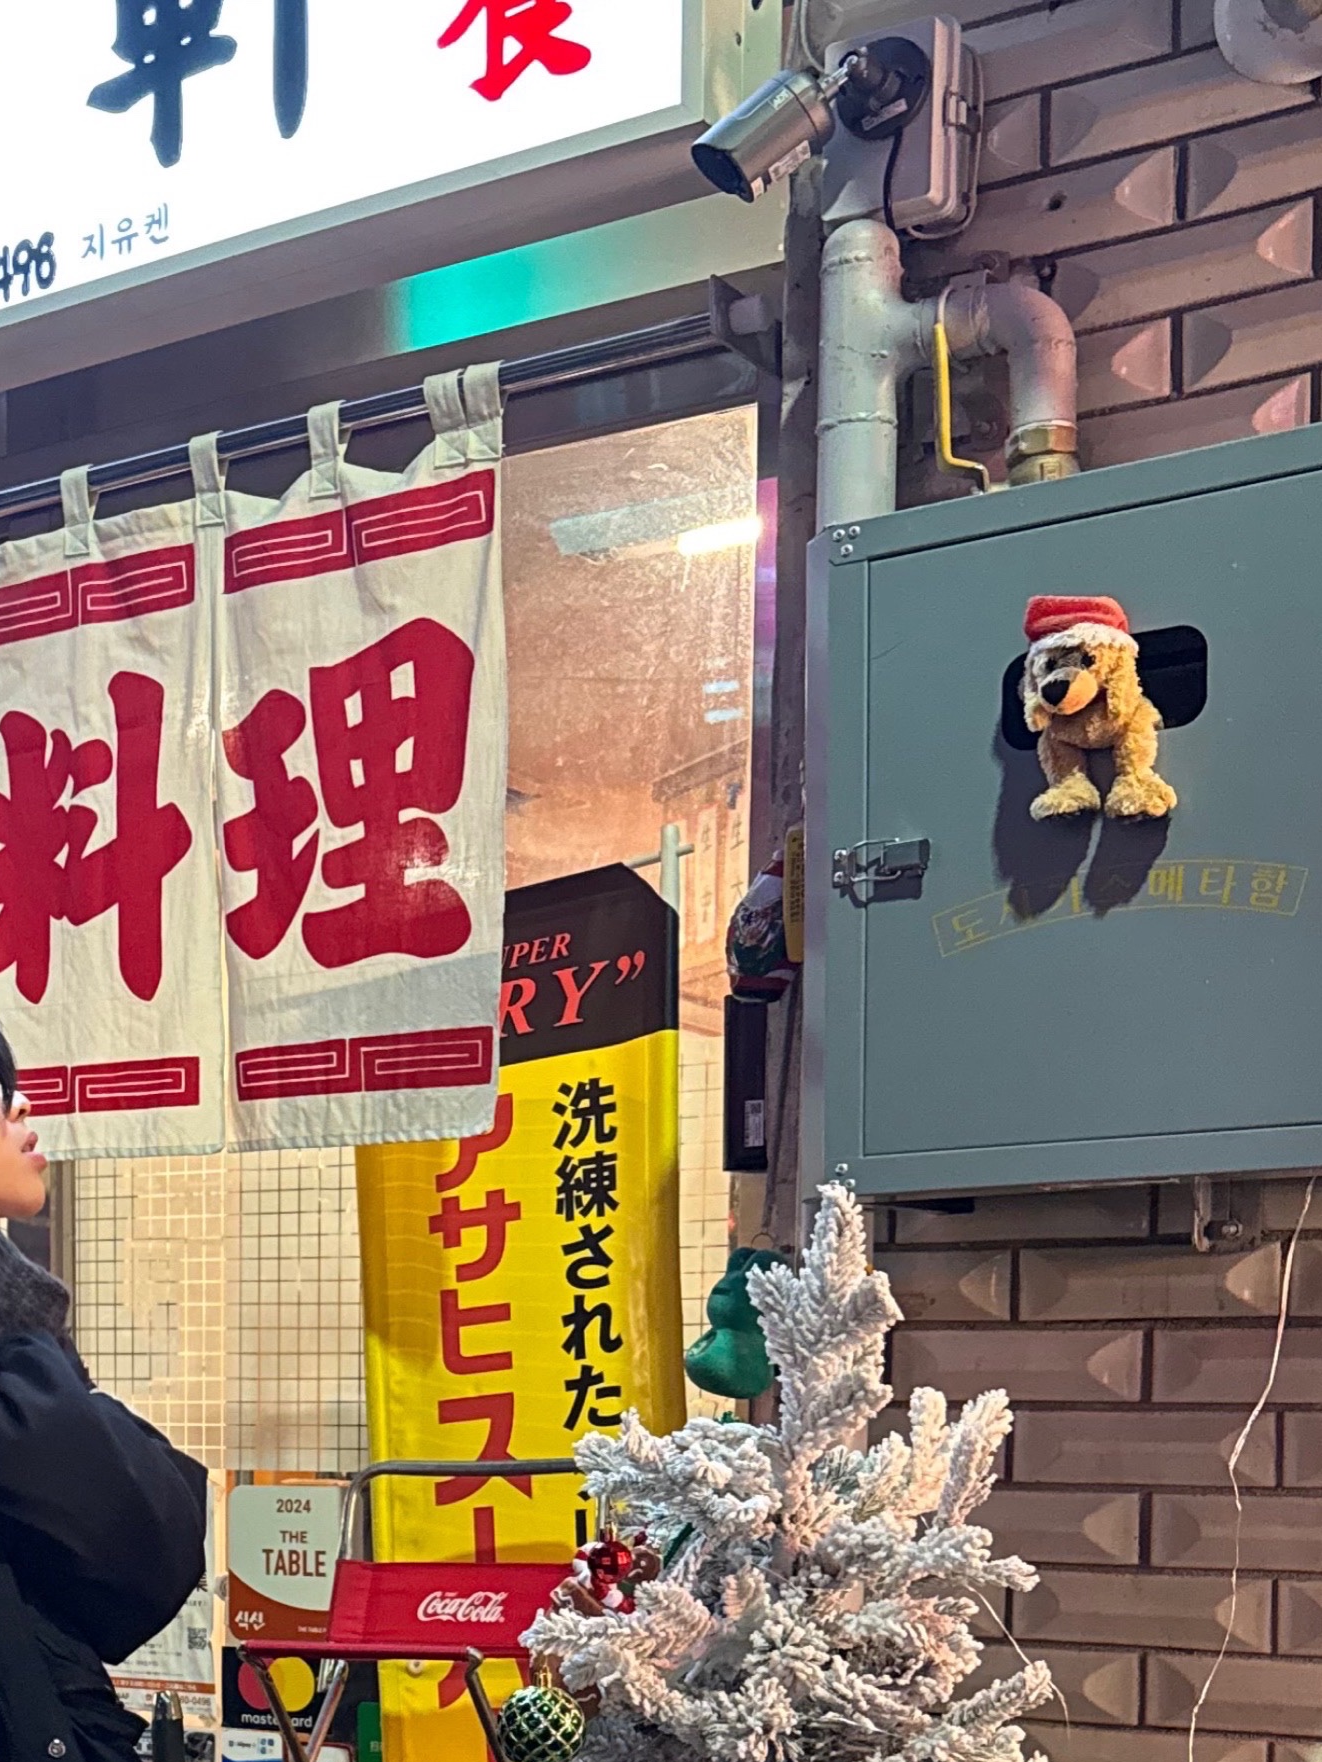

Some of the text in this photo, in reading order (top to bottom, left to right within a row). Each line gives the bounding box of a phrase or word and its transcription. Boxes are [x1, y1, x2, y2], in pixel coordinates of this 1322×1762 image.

[80, 202, 170, 260] 지유켄
[502, 932, 571, 969] PER
[552, 1077, 624, 1431] 洗練された
[276, 1499, 312, 1513] 2024
[279, 1530, 308, 1544] THE
[262, 1549, 327, 1578] TABLE
[241, 1713, 313, 1728] masteard
